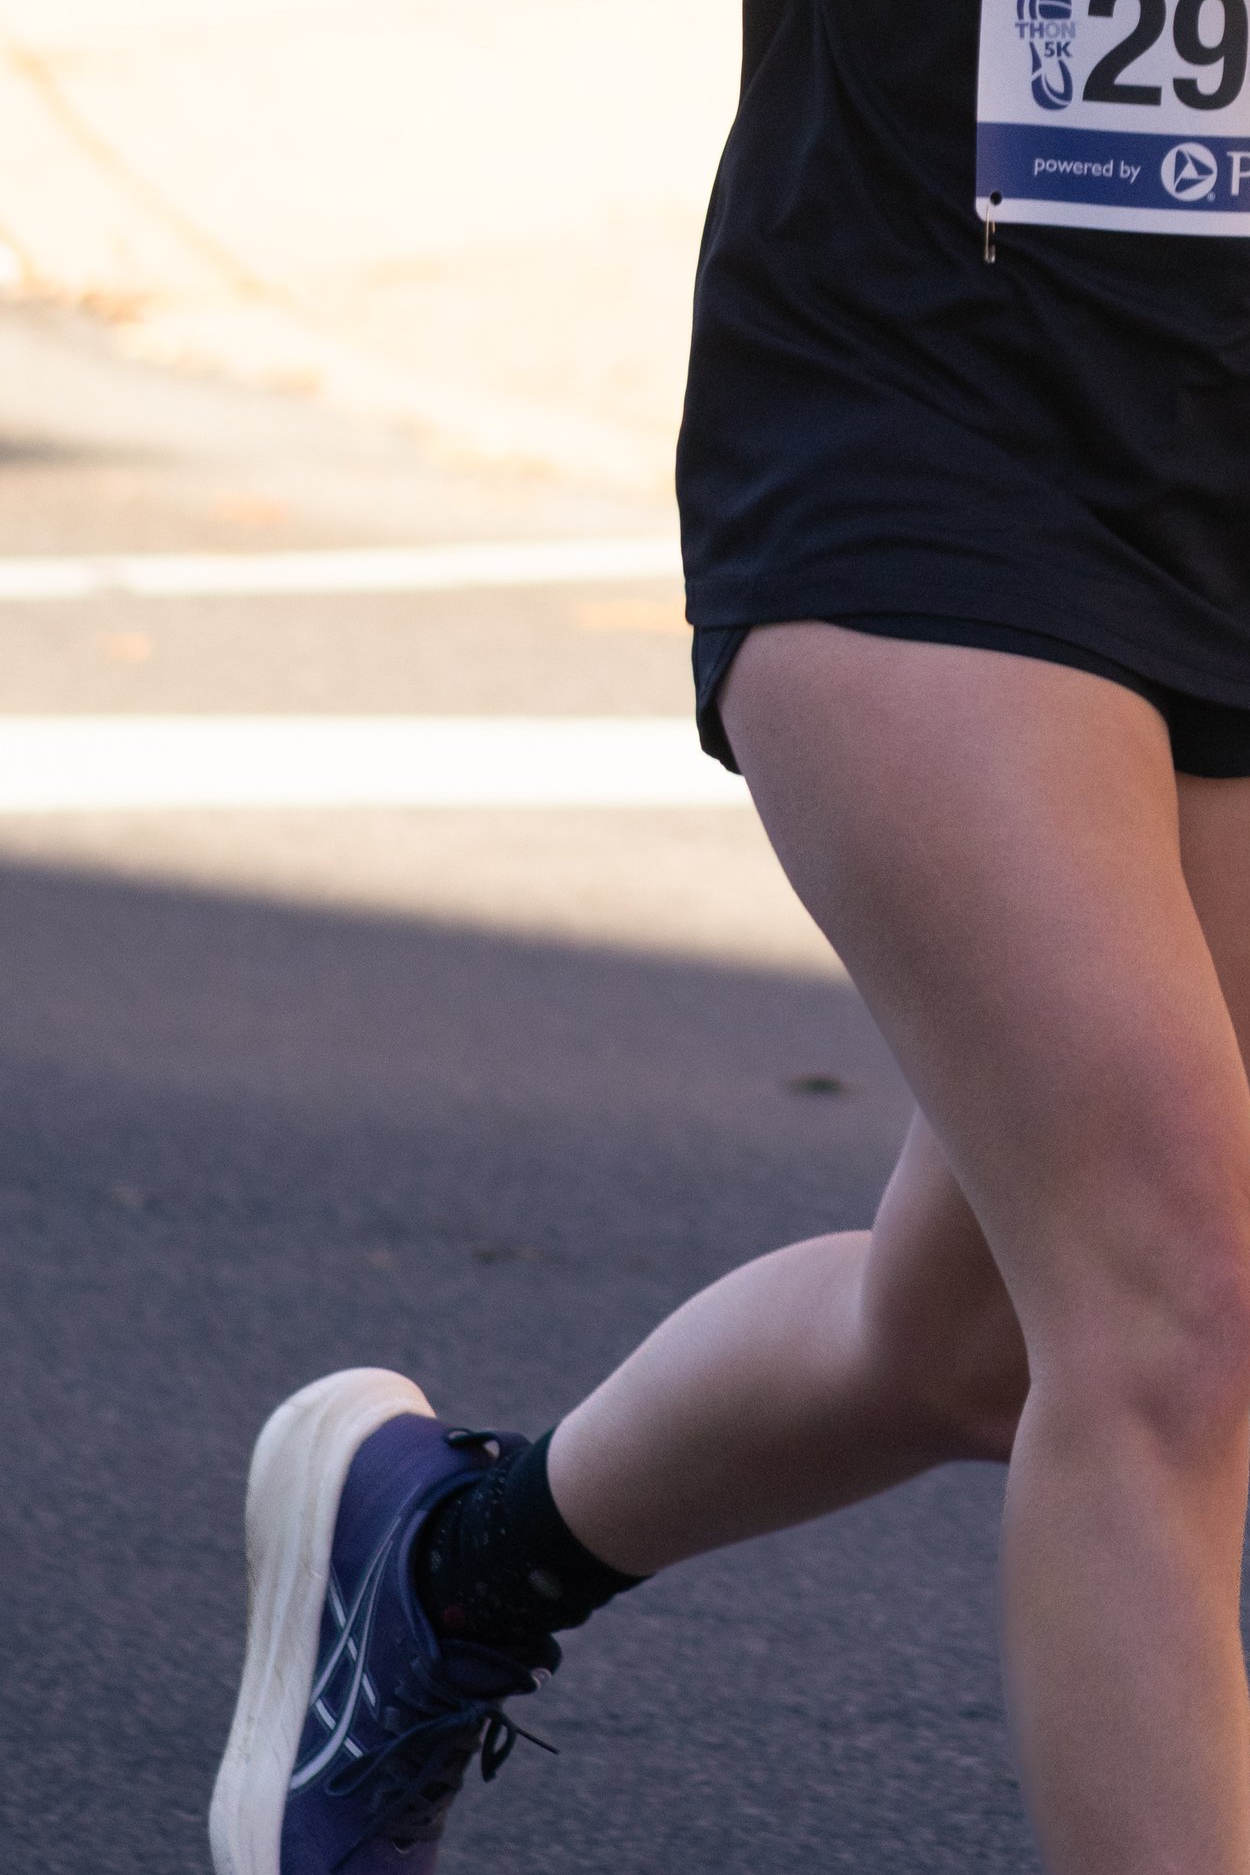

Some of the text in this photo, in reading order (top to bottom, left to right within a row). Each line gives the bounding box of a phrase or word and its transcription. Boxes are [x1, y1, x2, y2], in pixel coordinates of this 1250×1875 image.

[1014, 21, 1077, 40] THON
[1044, 40, 1073, 58] 5K
[1034, 157, 1142, 184] powered by
